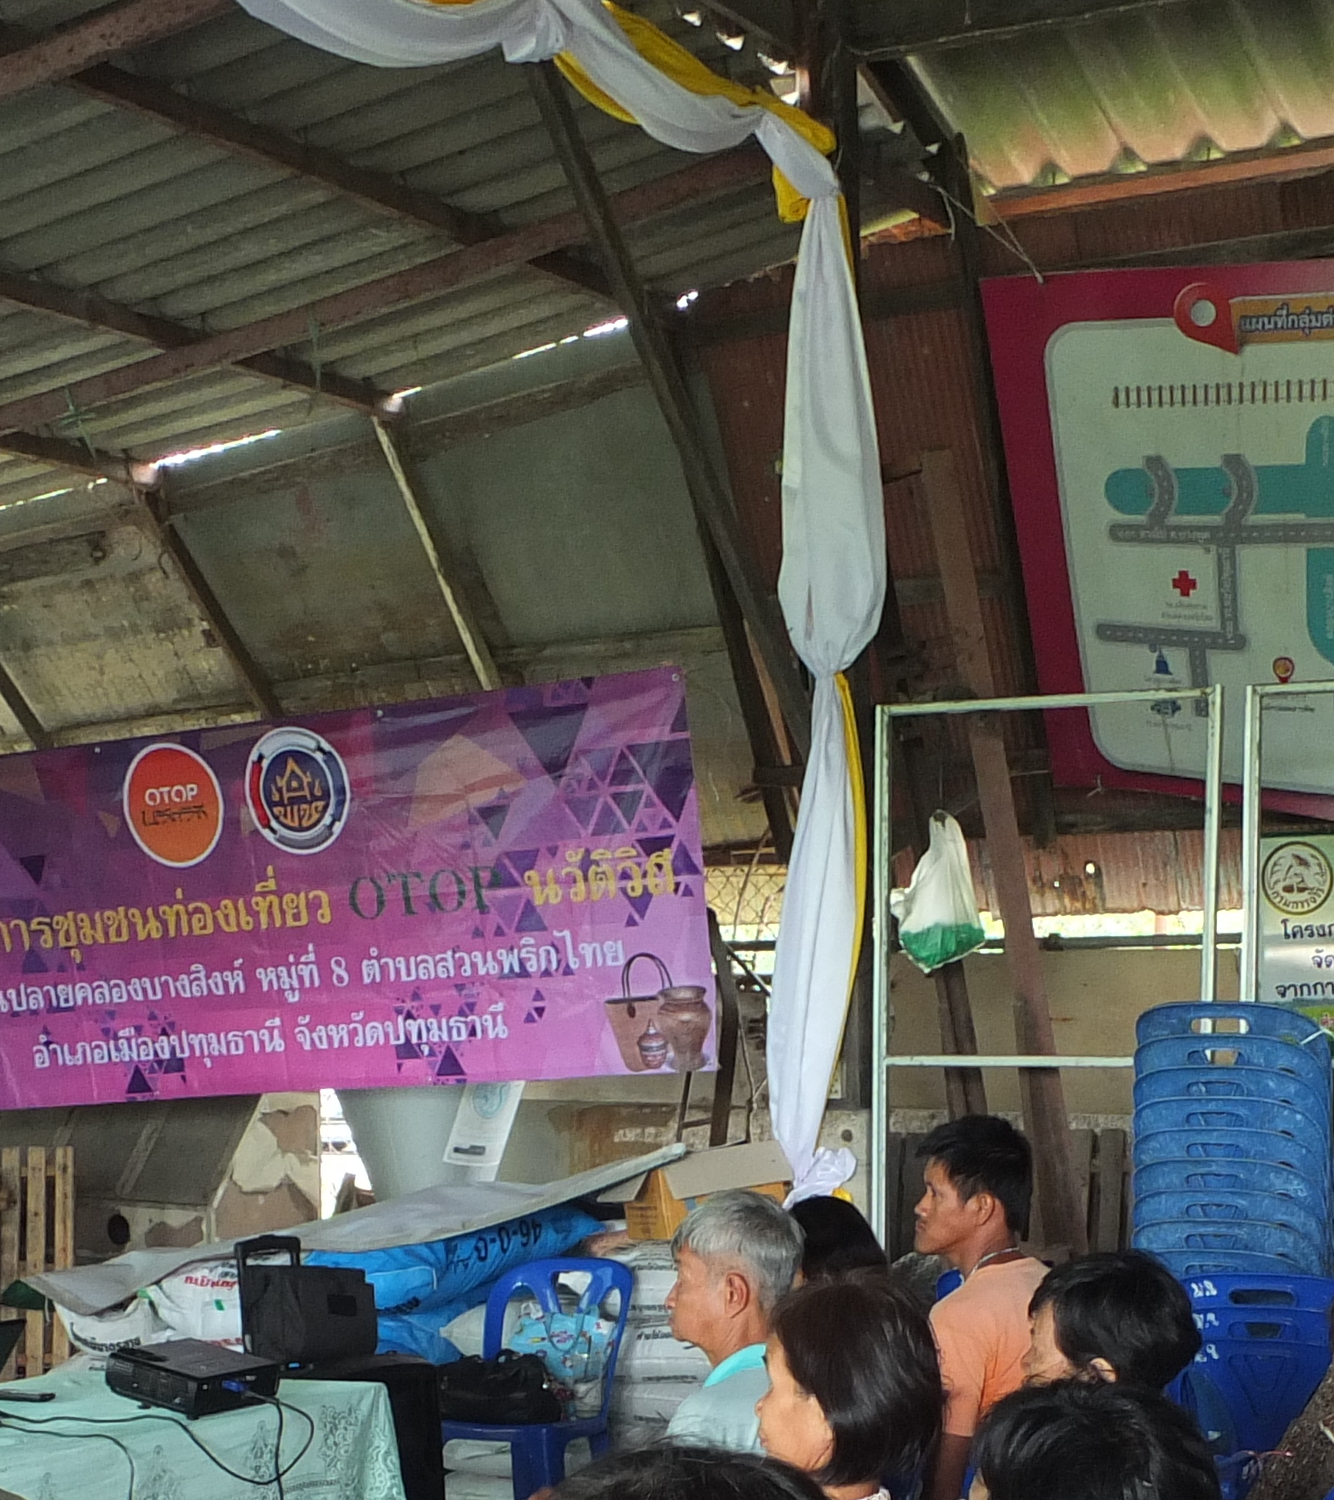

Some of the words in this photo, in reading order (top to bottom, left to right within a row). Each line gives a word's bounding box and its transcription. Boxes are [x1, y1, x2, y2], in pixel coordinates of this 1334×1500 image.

[144, 783, 199, 807] OTOP
[349, 865, 504, 920] OTOP
[256, 943, 321, 1003] หมู่ที่
[331, 956, 350, 987] 8
[361, 930, 625, 984] ตำบลสวนพริกไทย
[33, 1017, 285, 1070] อำเภอเมืองปทุมธานี
[295, 1003, 508, 1056] จังหวัดปทุมธานี
[475, 1219, 544, 1264] 46-0-0
